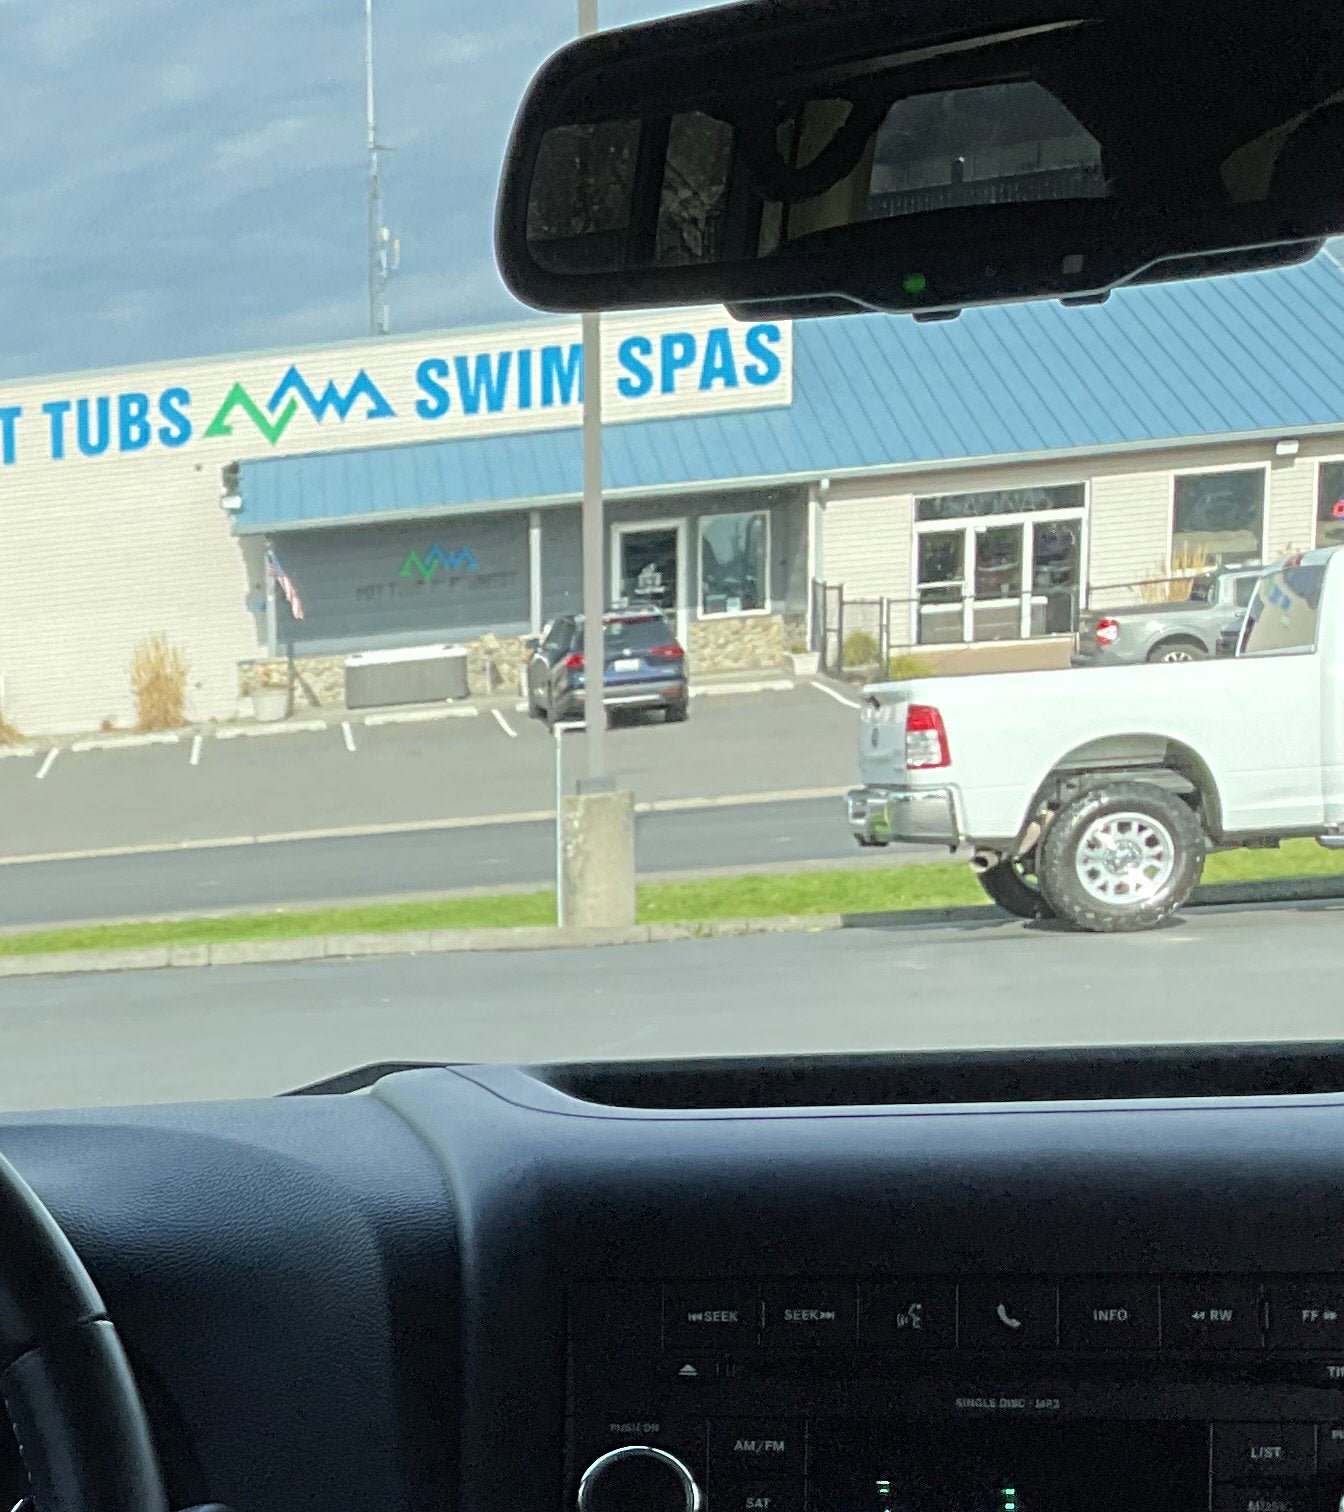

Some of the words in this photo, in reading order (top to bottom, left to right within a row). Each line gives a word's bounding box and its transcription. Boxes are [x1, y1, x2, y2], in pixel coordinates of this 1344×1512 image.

[414, 342, 584, 421] SWIM
[616, 323, 783, 399] SPAS
[42, 387, 194, 461] TUBS
[703, 1310, 739, 1322] SEEK
[784, 1308, 820, 1321] SEEK
[1092, 1307, 1130, 1321] INFO
[1211, 1308, 1233, 1321] RW
[733, 1440, 786, 1454] AM/FM
[1250, 1445, 1284, 1460] LIST
[745, 1497, 773, 1510] SAT
